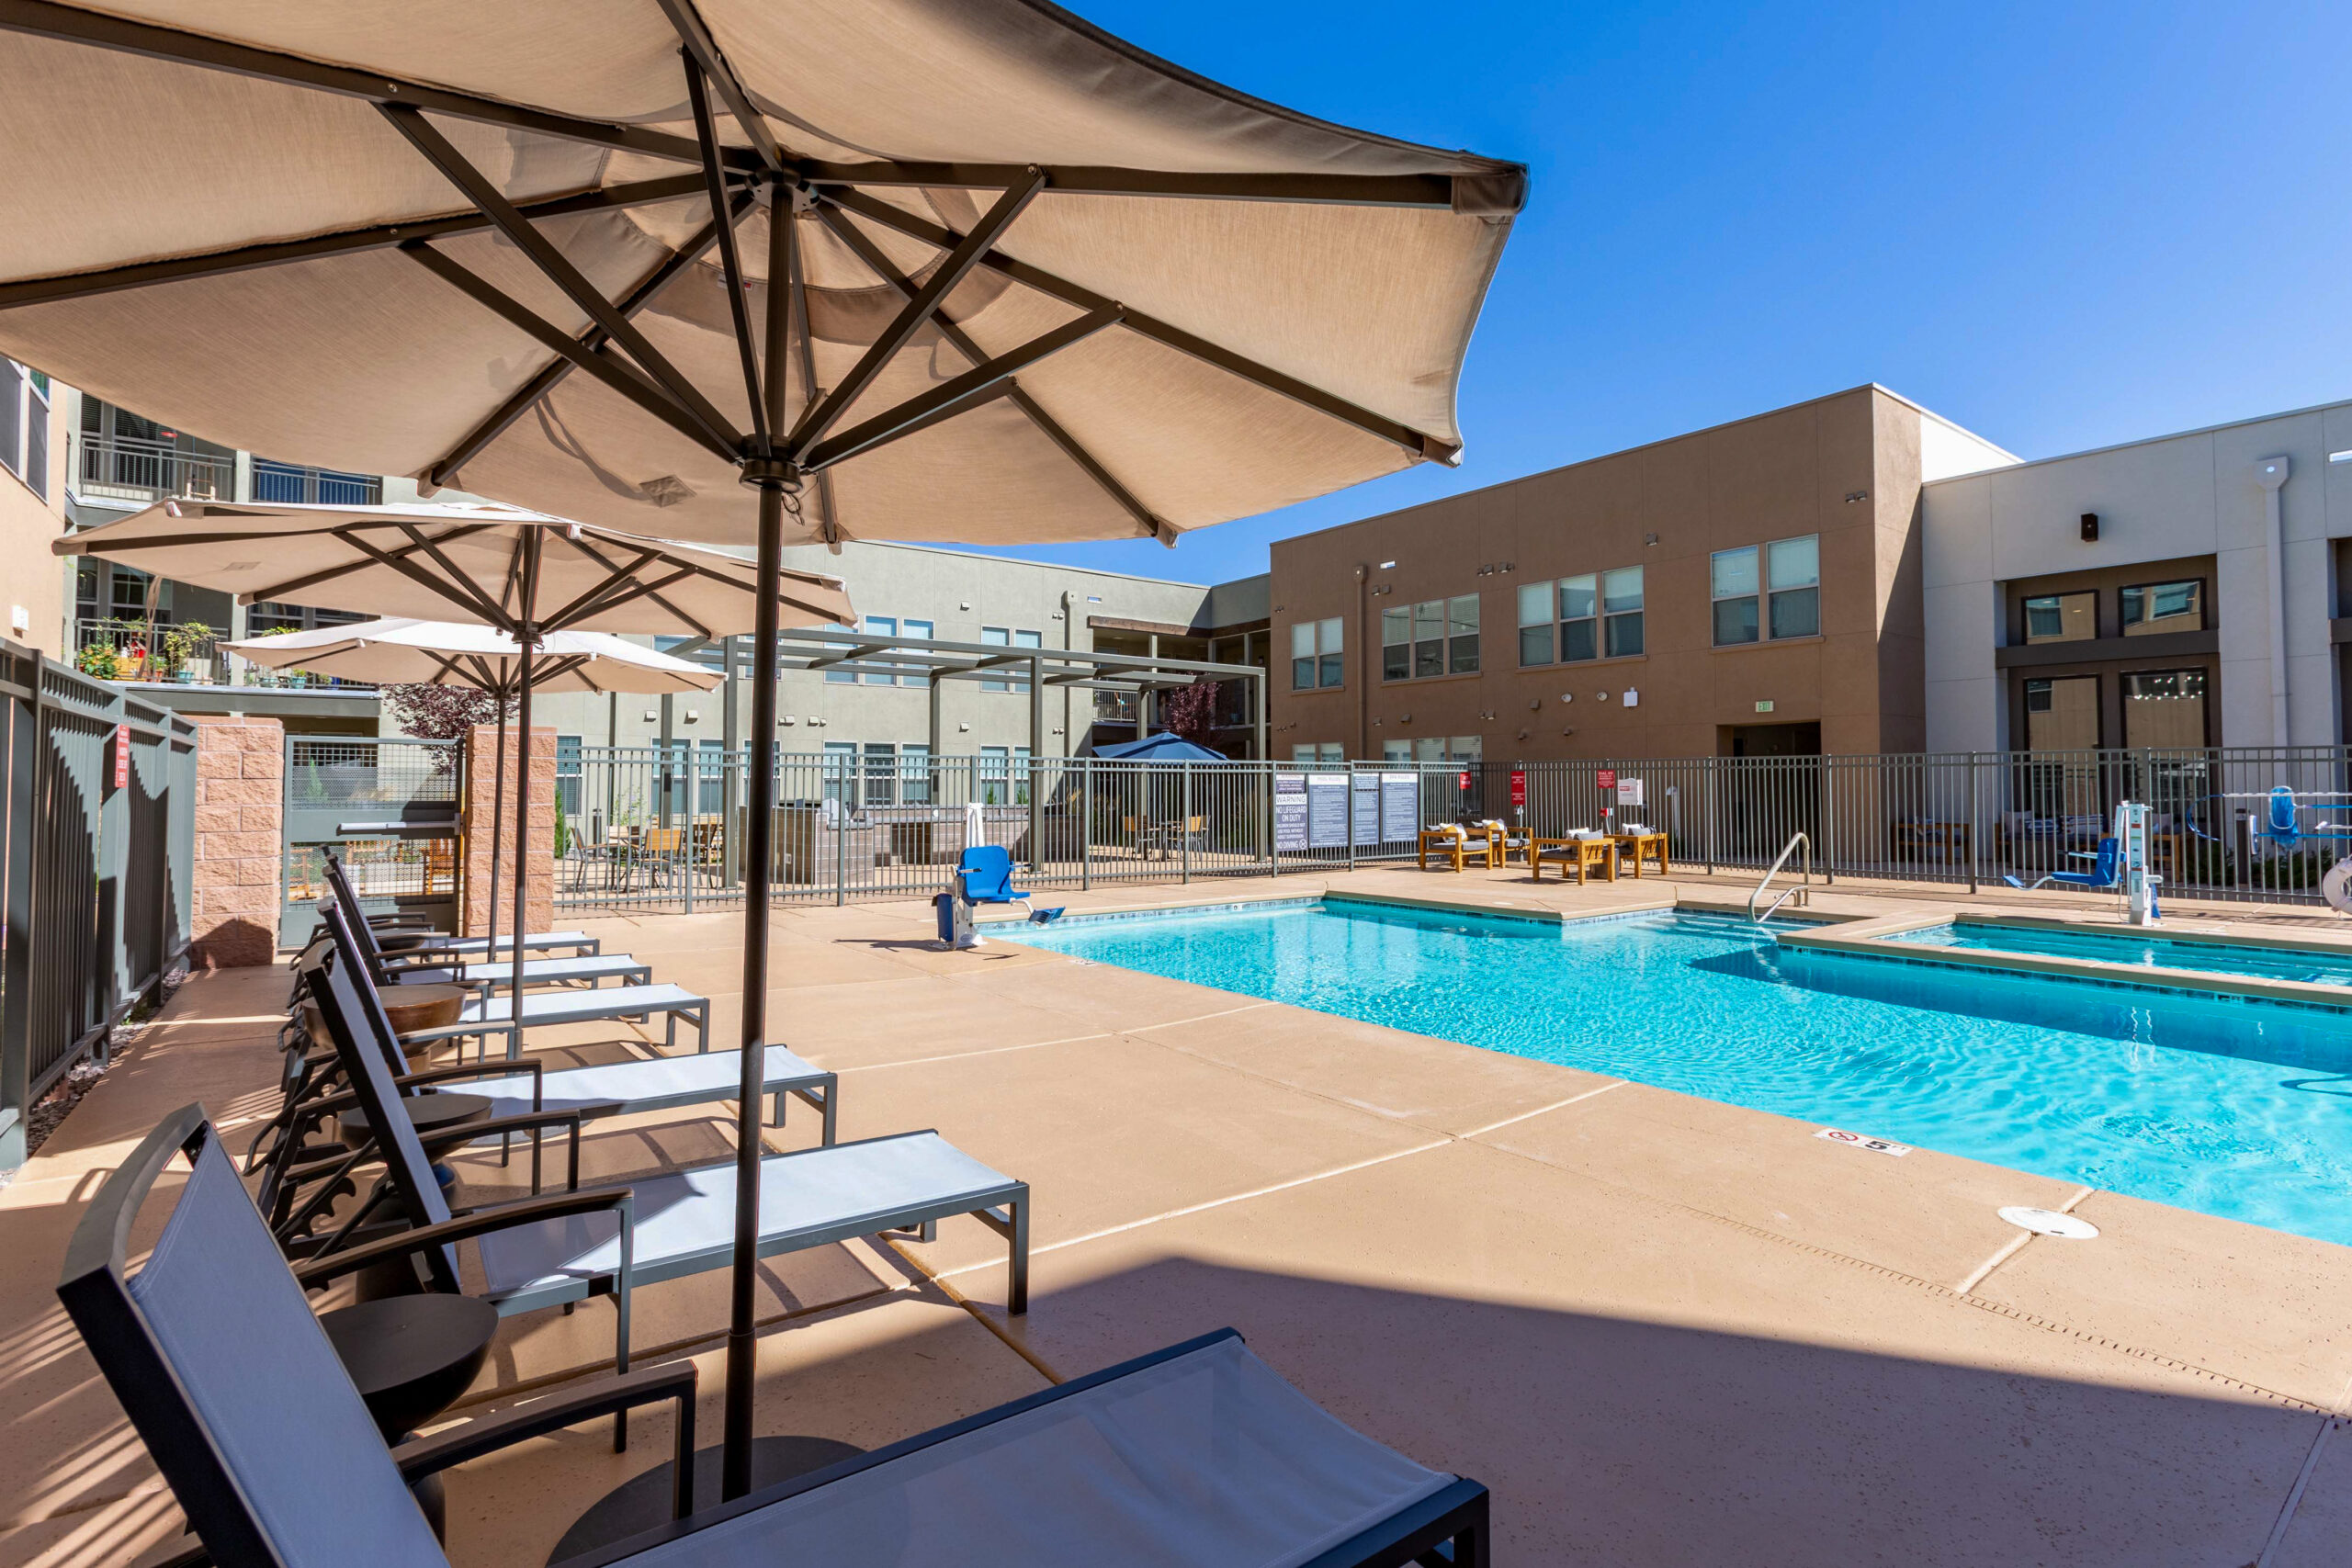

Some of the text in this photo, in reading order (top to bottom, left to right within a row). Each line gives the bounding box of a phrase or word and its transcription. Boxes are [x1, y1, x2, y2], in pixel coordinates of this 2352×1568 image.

[1277, 795, 1306, 804] WARNING
[1275, 806, 1306, 814] NO LIFEGUARD
[1282, 814, 1301, 822] ON DUTY
[1276, 840, 1298, 849] NO DIVING
[1864, 1140, 1891, 1150] 5
